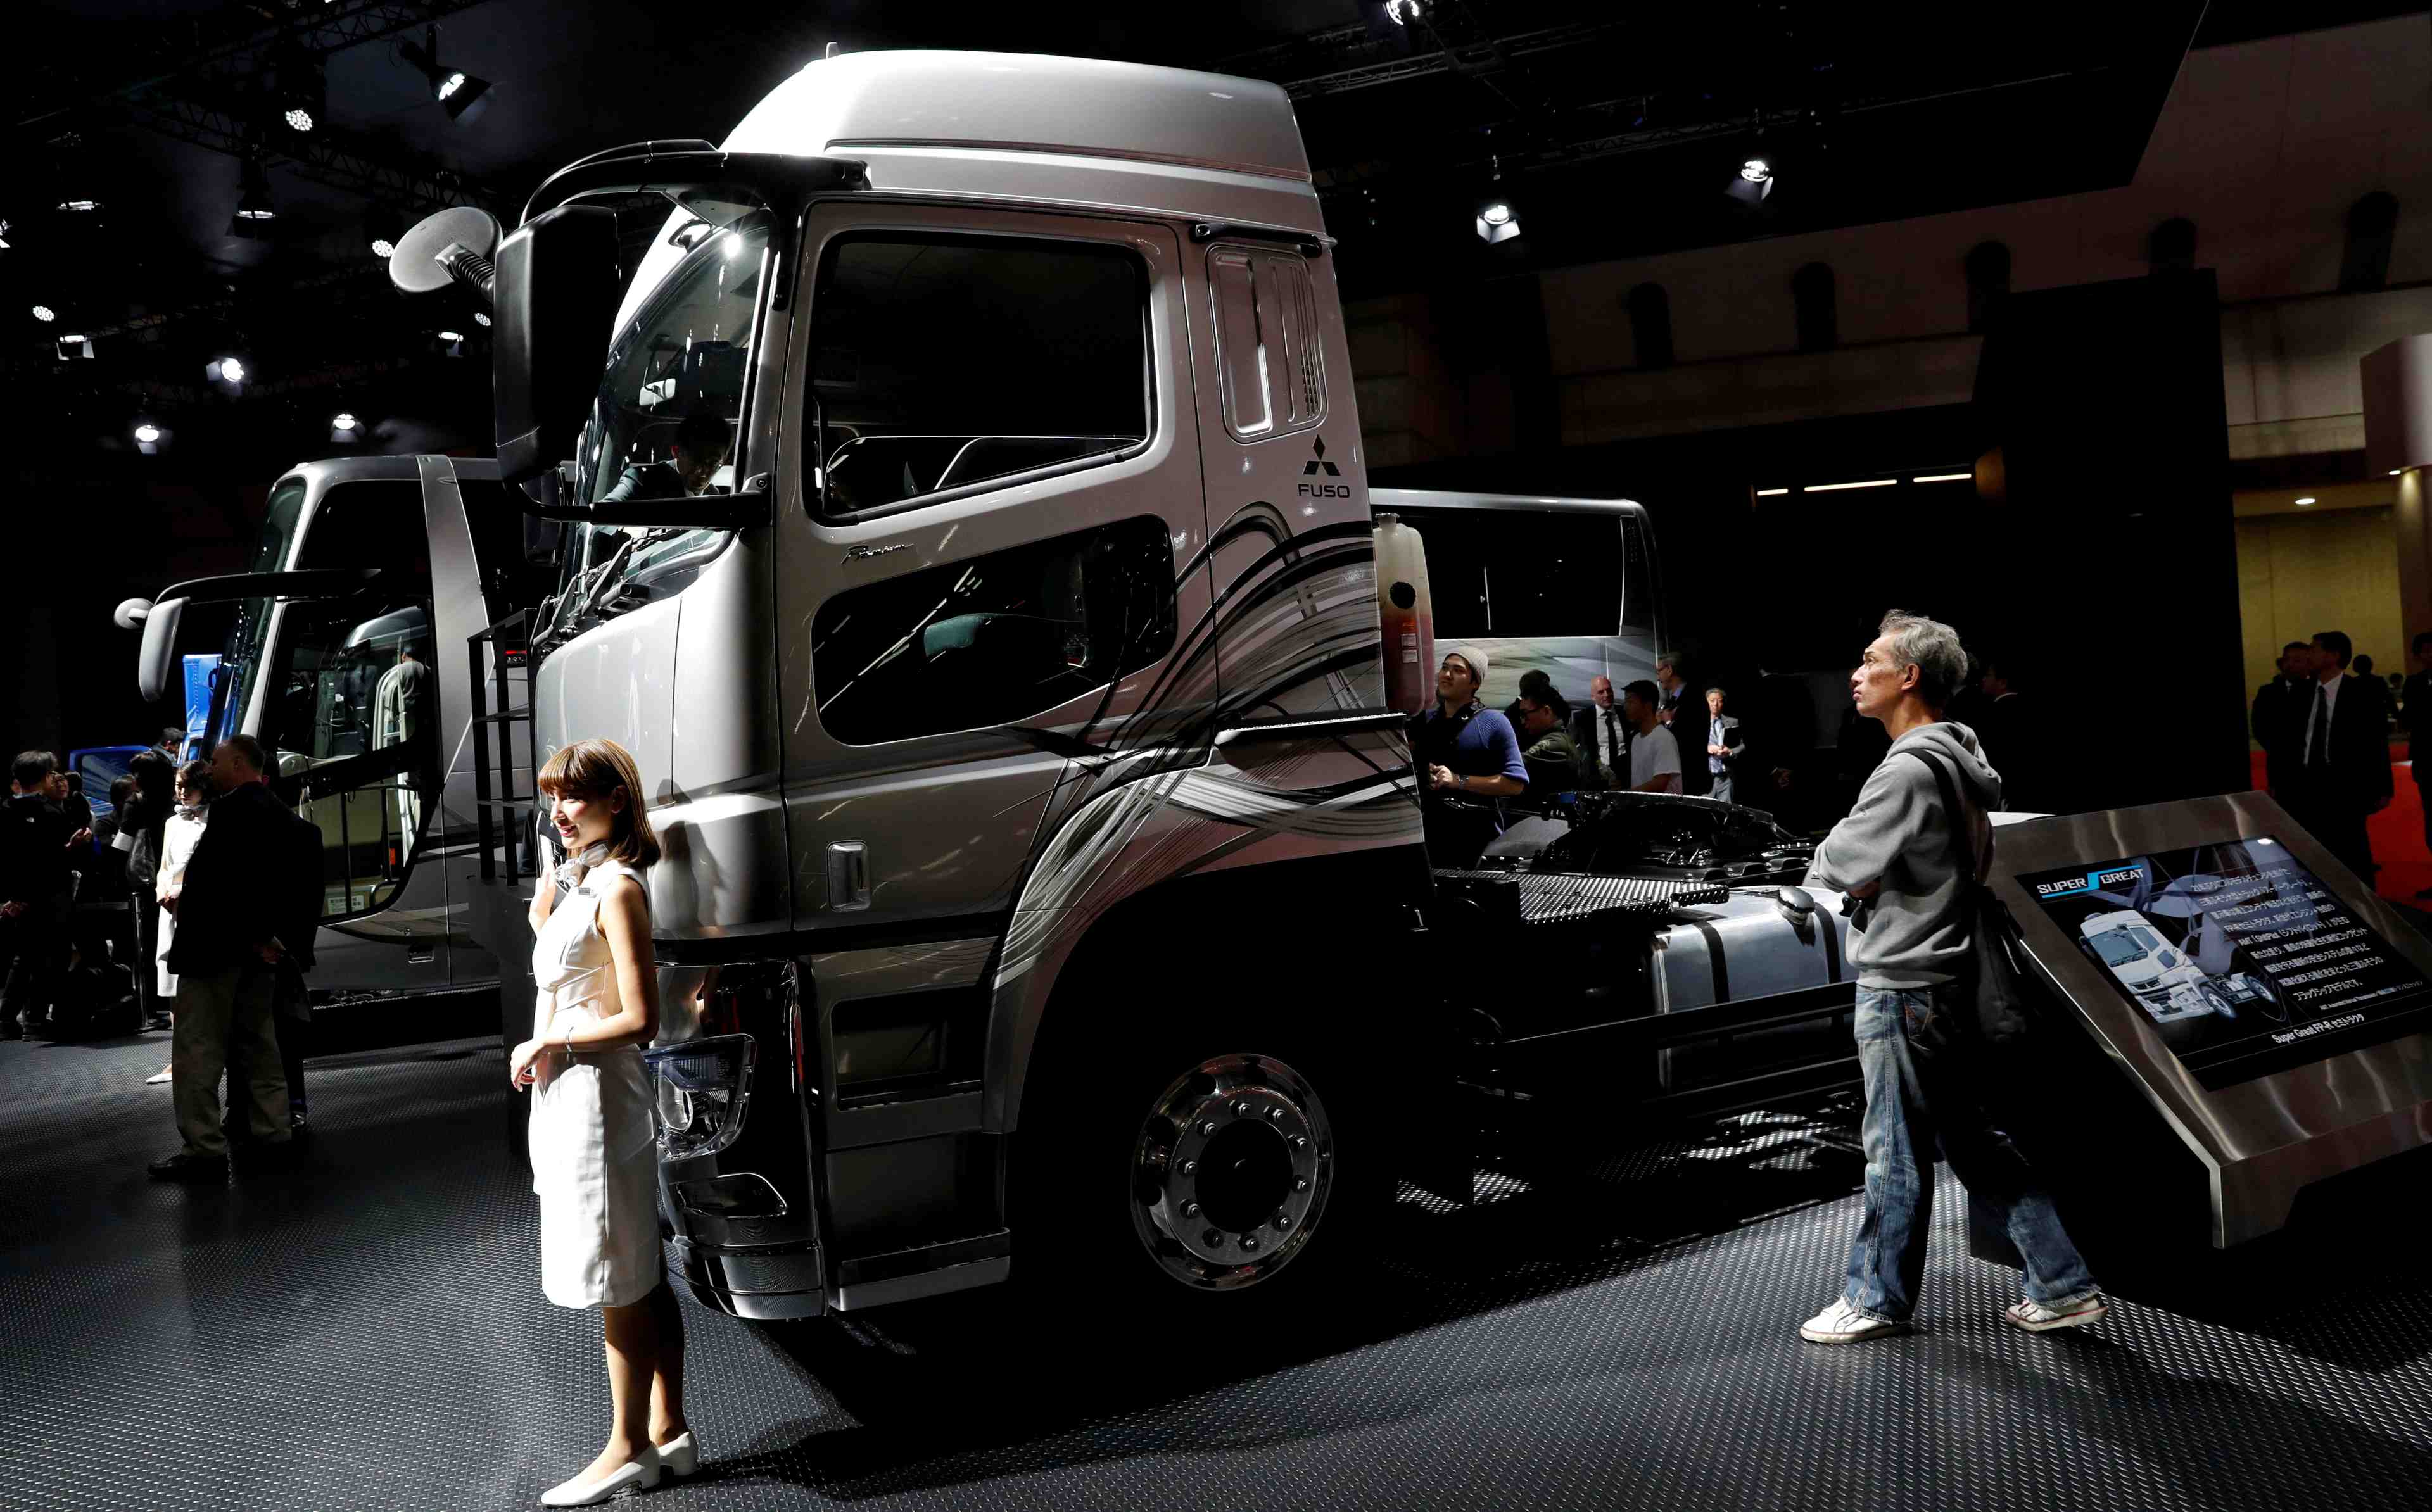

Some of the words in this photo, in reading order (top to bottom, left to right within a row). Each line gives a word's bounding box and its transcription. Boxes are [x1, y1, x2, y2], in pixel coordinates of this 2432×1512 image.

[1297, 483, 1350, 498] FUSO
[2036, 878, 2087, 894] SUPER
[2100, 868, 2144, 885] GREAT
[2271, 1032, 2296, 1043] Super
[2293, 1026, 2318, 1037] Great
[2331, 1013, 2365, 1028] セミトラクタ
